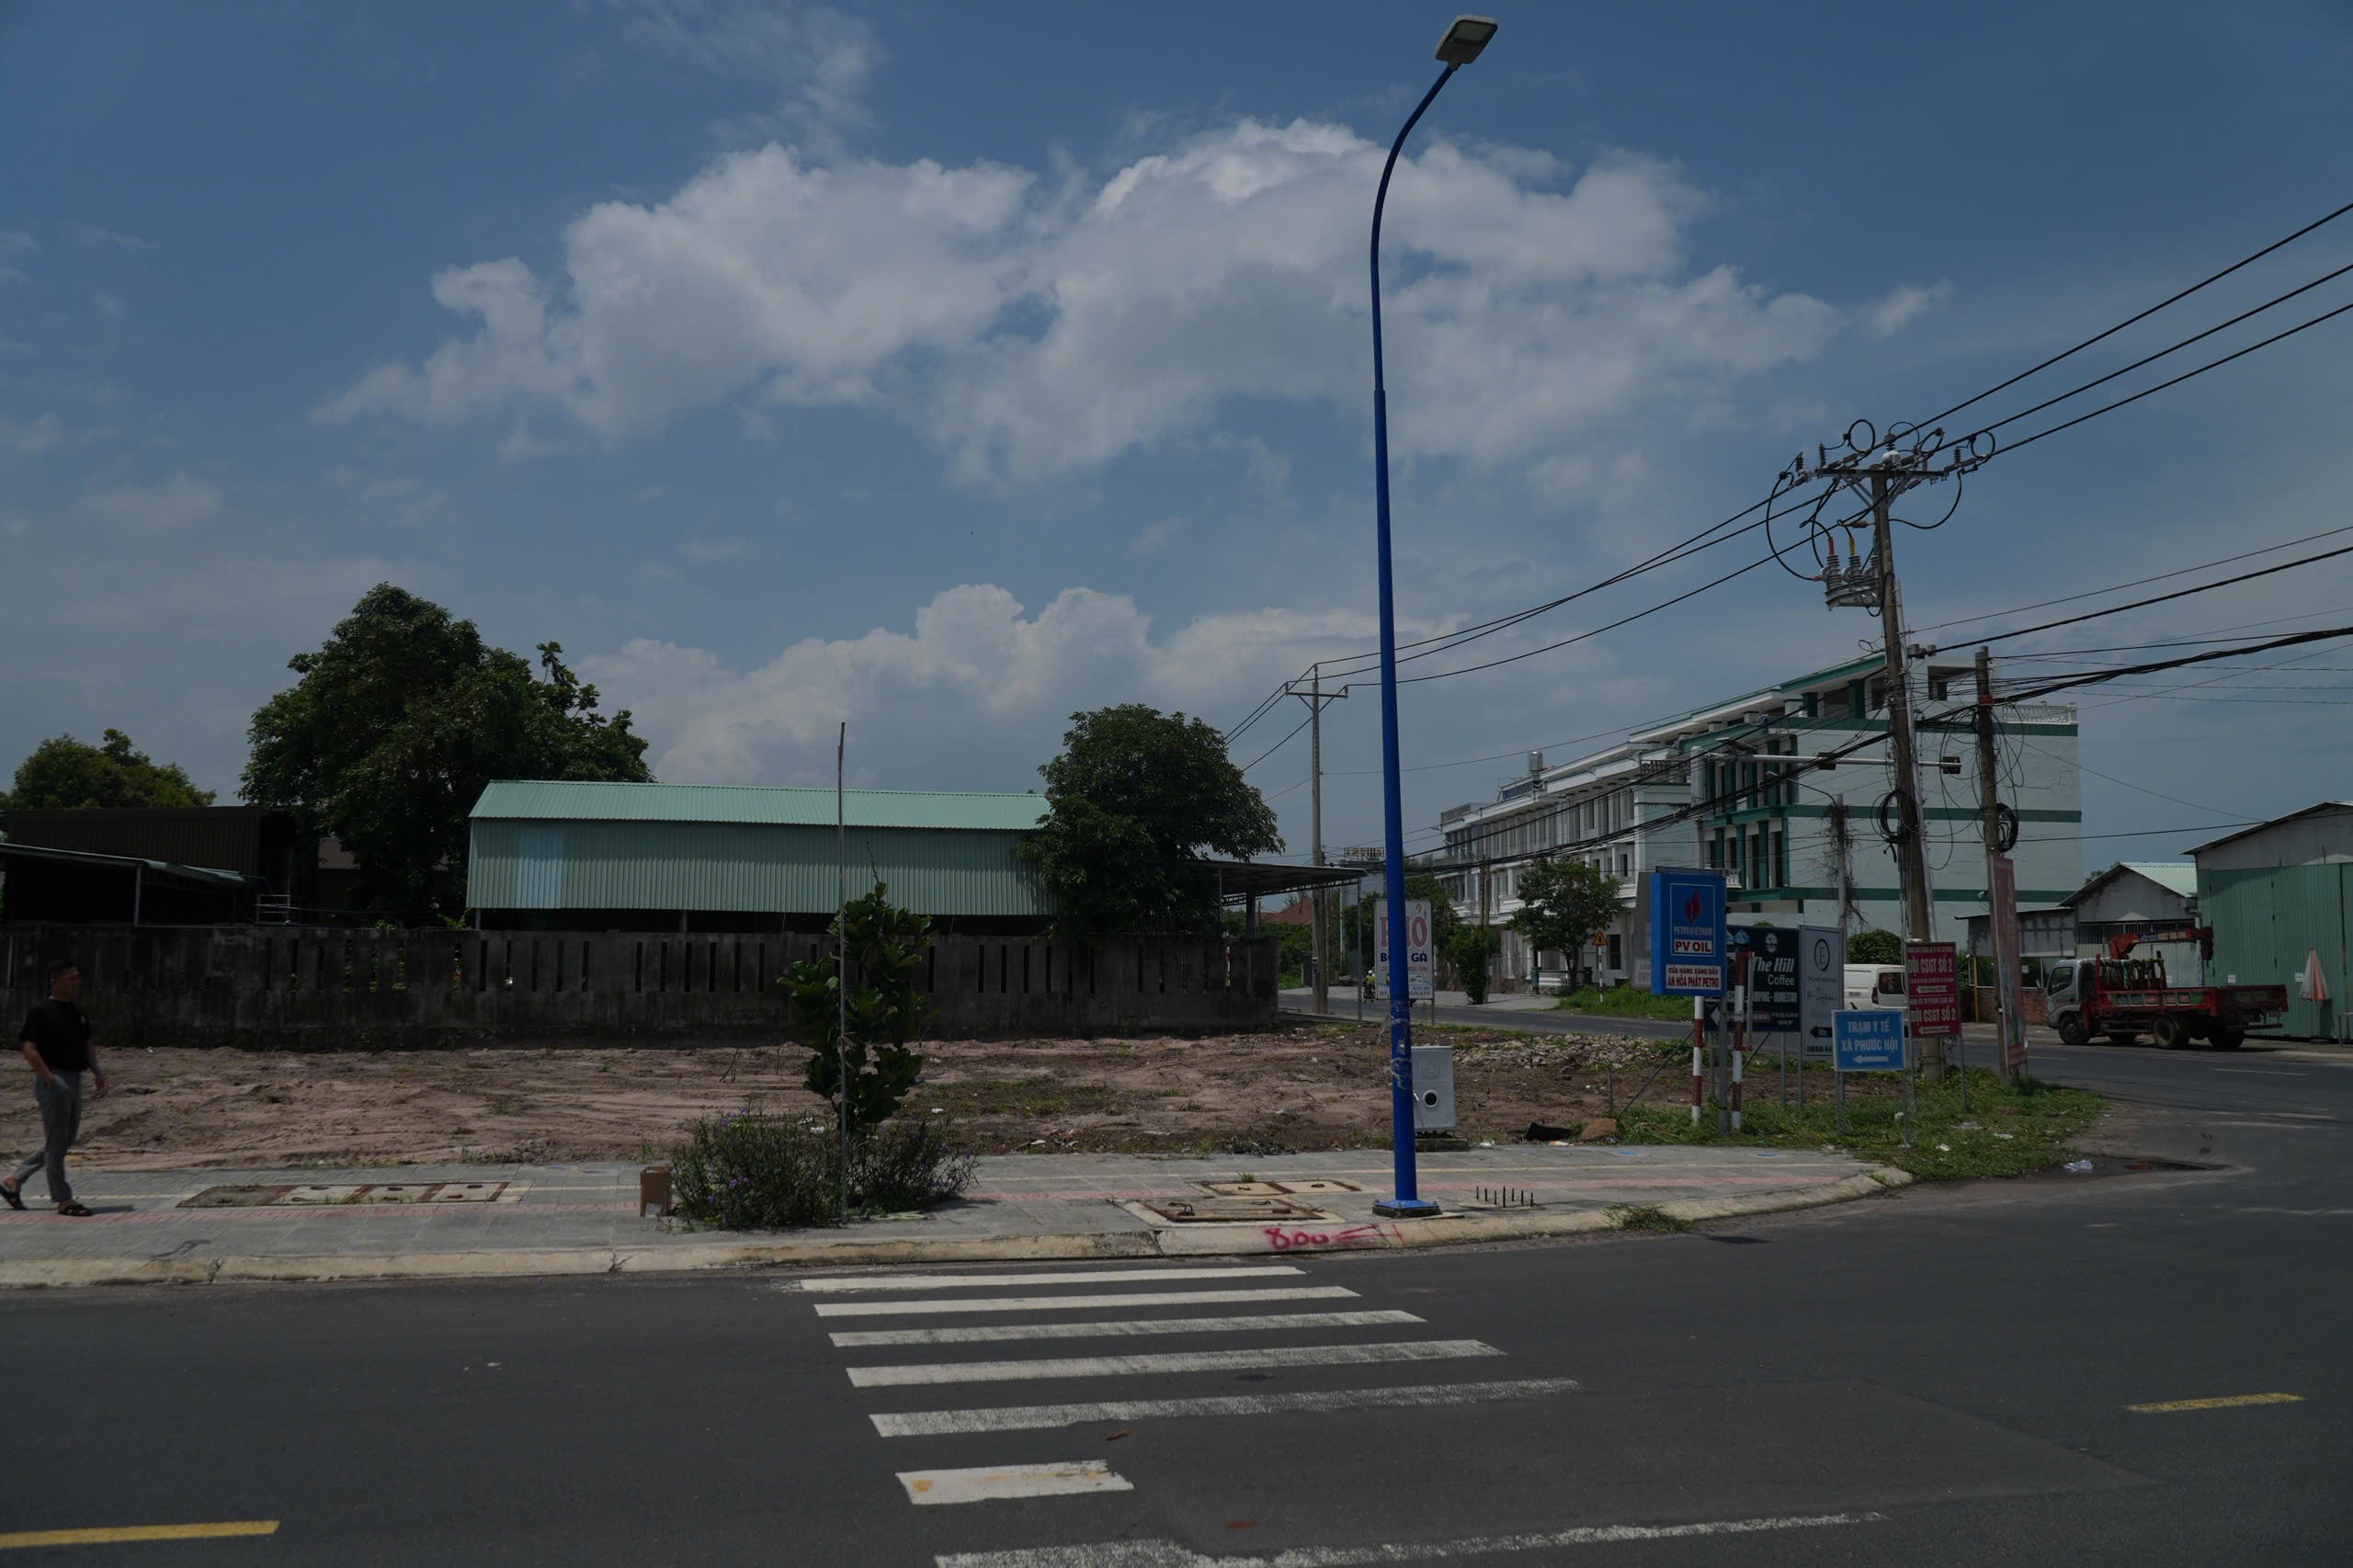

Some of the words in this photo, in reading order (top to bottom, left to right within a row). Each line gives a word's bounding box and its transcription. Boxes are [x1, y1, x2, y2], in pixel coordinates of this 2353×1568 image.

[1676, 941, 1690, 951] PV
[1693, 942, 1711, 952] OIL
[1412, 951, 1427, 962] GÀ
[1668, 966, 1678, 974] CỬA
[1754, 957, 1772, 971] The
[1774, 958, 1795, 972] Hill
[1948, 959, 1953, 972] 2
[1668, 977, 1675, 986] AN
[1688, 975, 1701, 987] PHÁT
[1702, 977, 1720, 988] PETRO
[1768, 974, 1795, 985] Coffee
[1923, 1008, 1939, 1022] CSGT
[1951, 1007, 1956, 1020] 2
[1847, 1020, 1870, 1035] TRẠM
[1873, 1020, 1879, 1032] Y
[1881, 1017, 1891, 1032] TẾ
[1841, 1038, 1853, 1051] XÃ
[1884, 1038, 1898, 1053] HỘI
